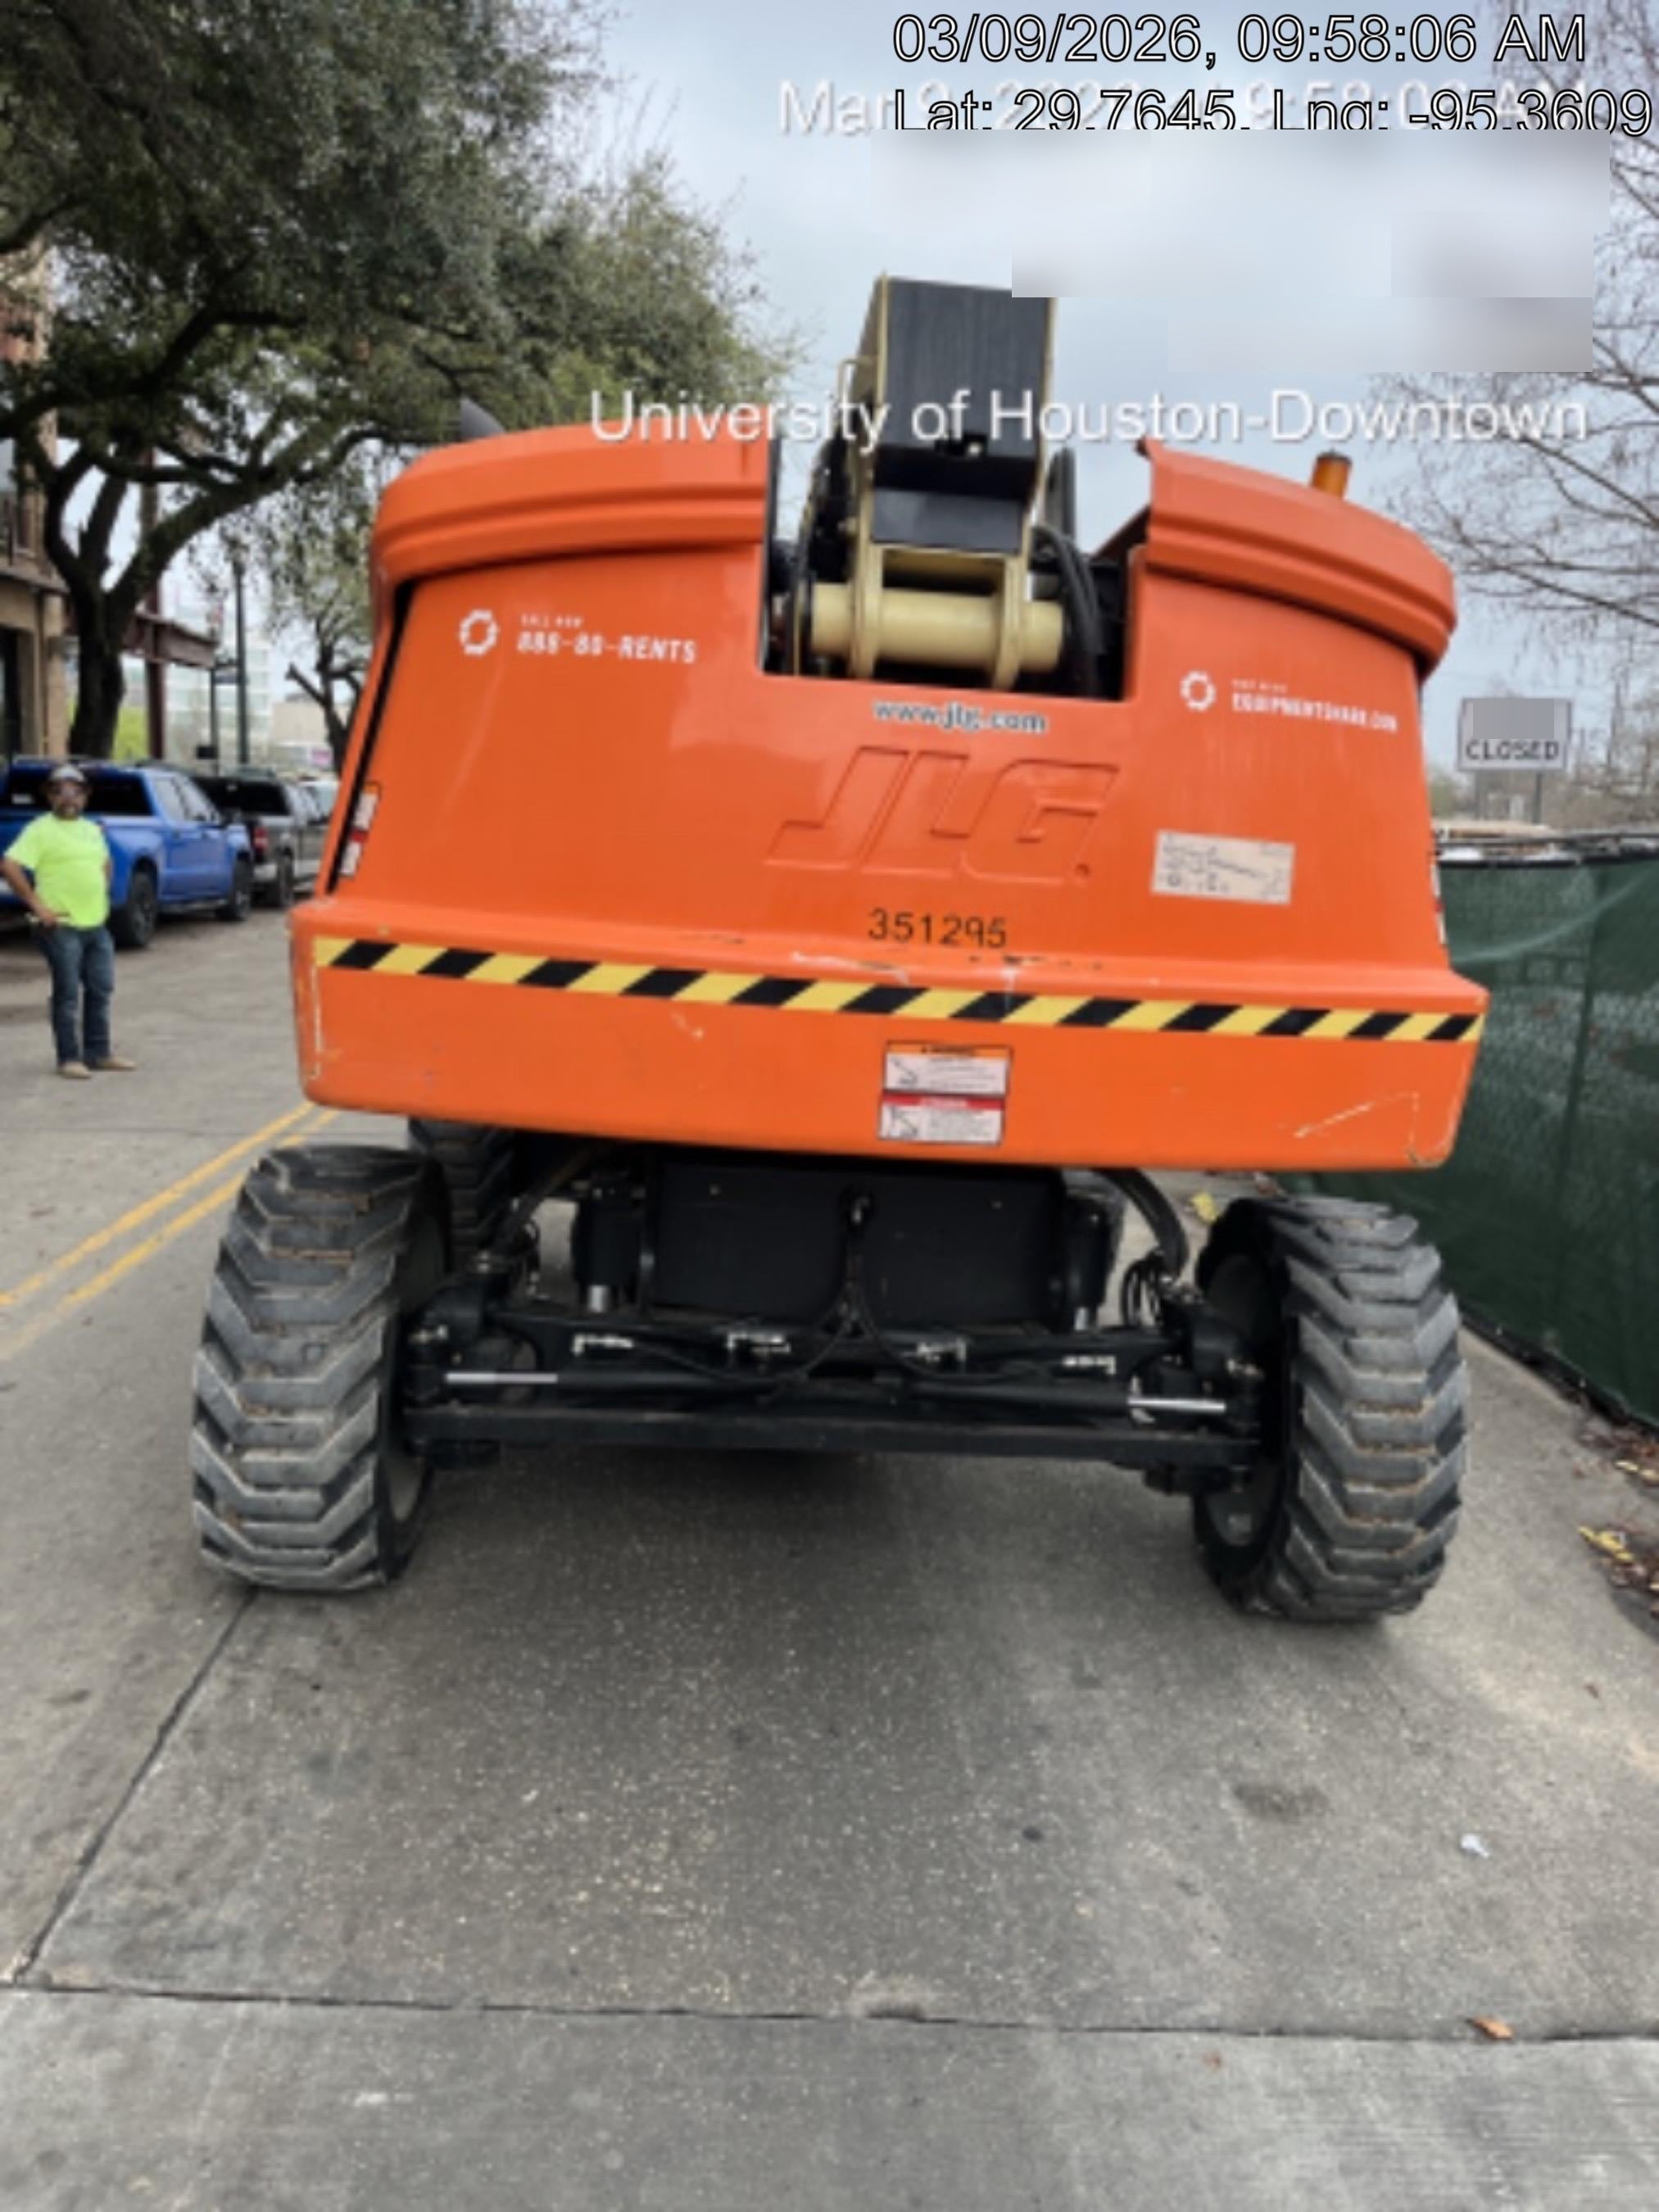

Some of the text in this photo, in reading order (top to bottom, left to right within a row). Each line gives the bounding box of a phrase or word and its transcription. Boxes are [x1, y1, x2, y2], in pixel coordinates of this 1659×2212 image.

[873, 700, 1047, 734] www.jlg.com
[1465, 738, 1560, 760] CLOSED
[764, 744, 1120, 886] JLG
[867, 907, 1007, 950] 351295
